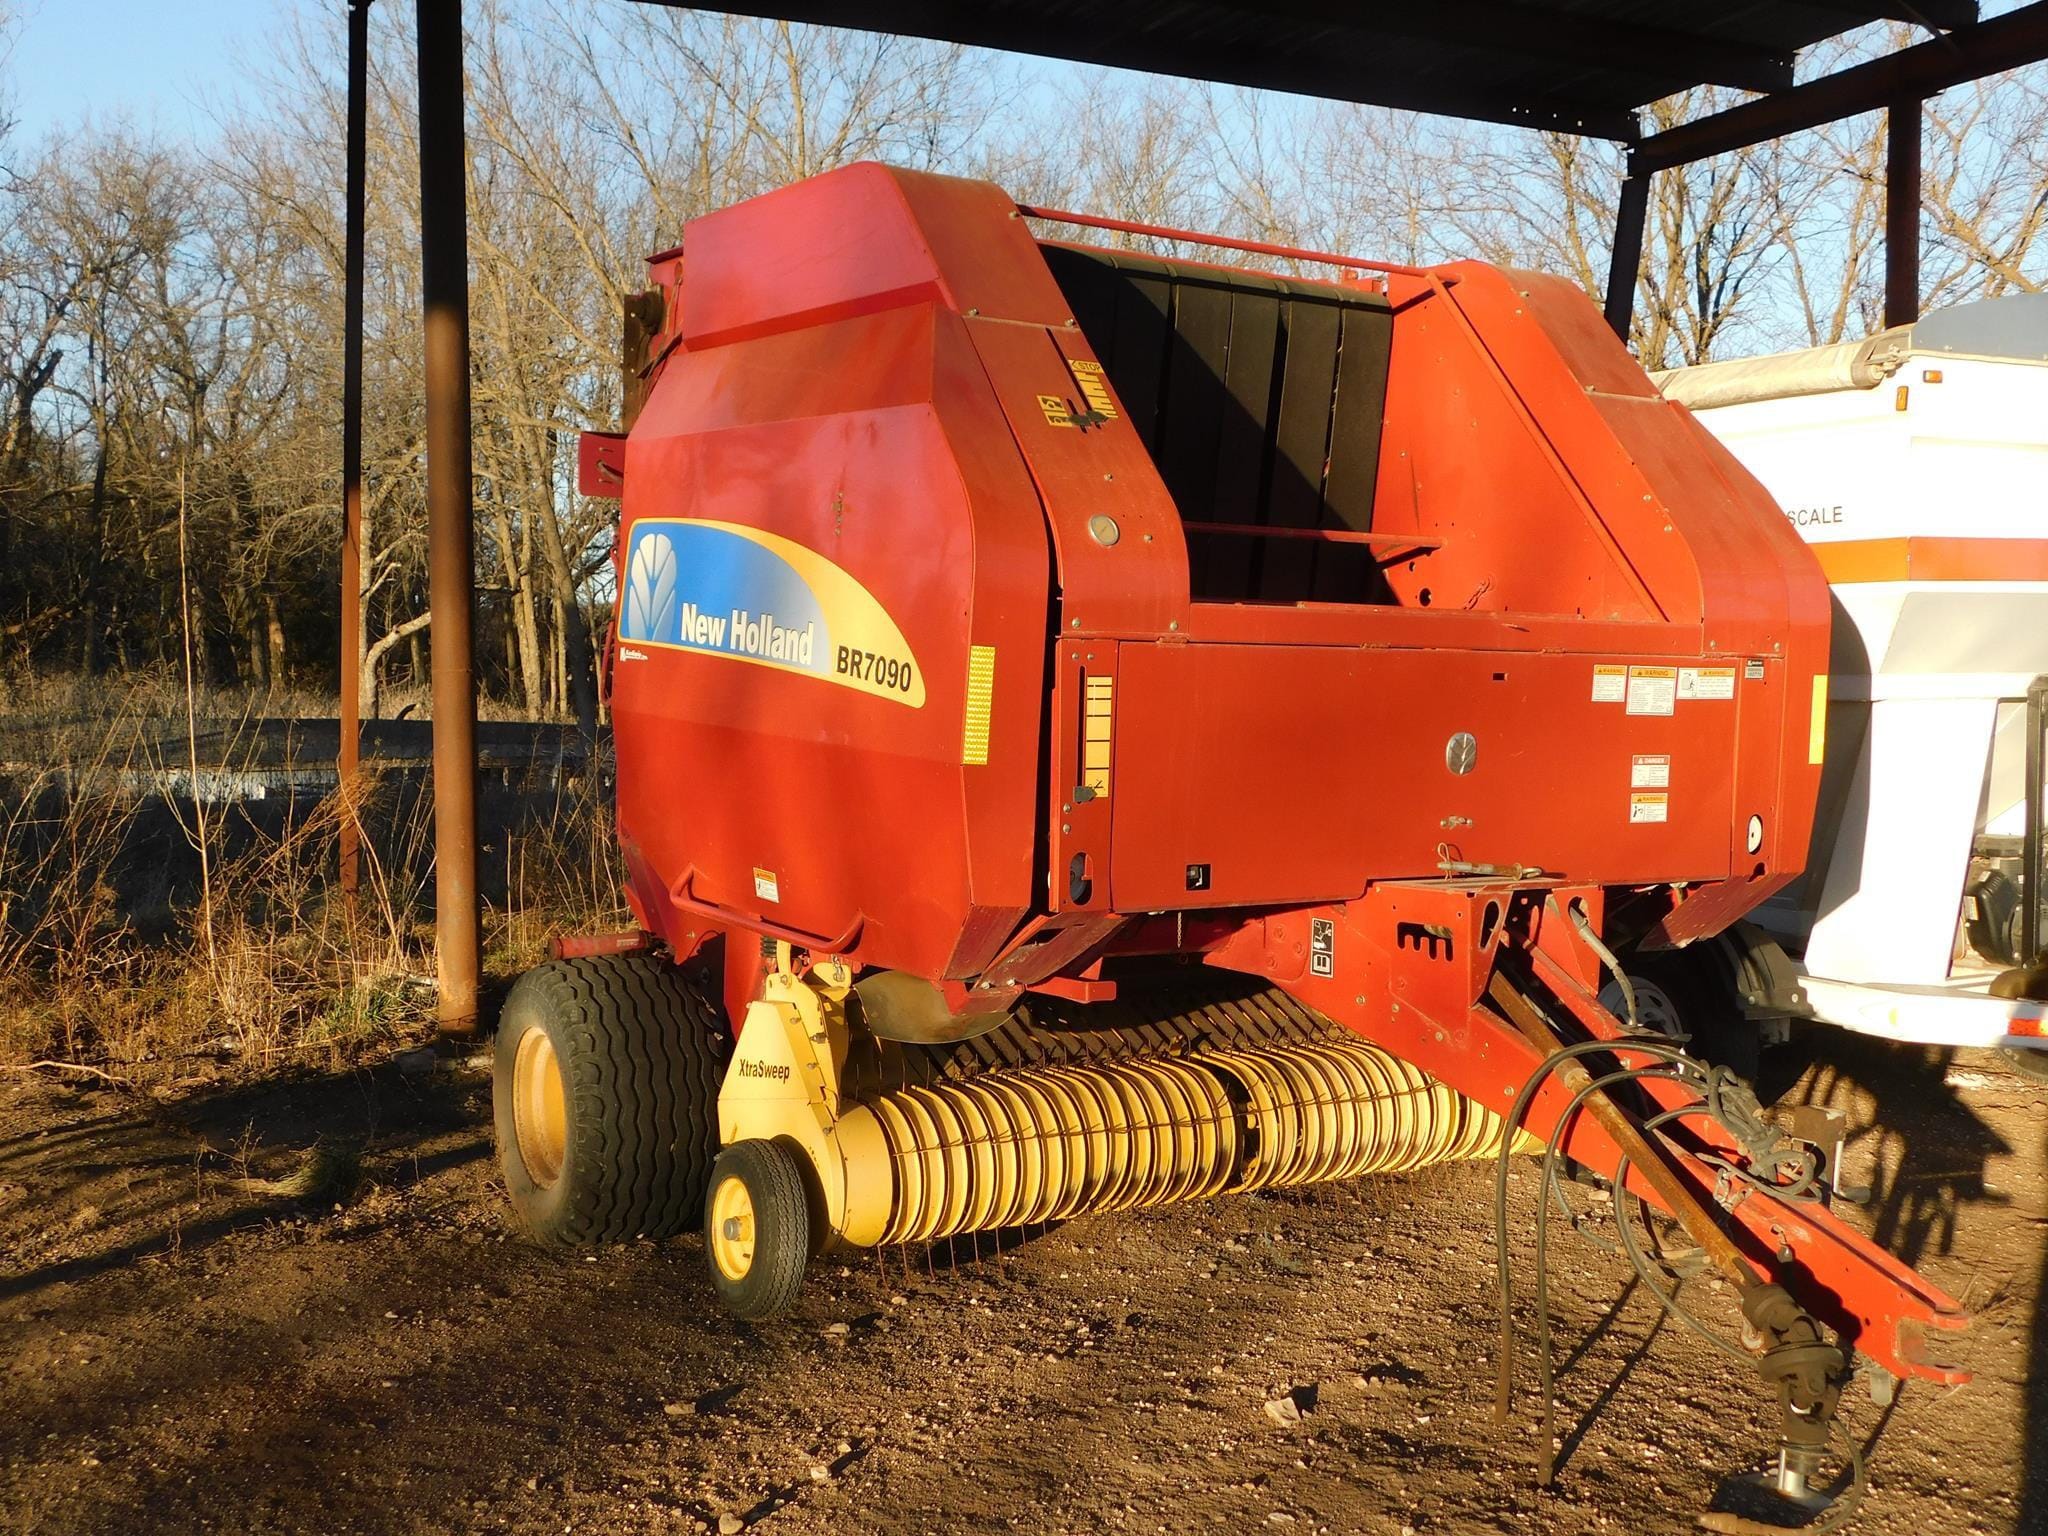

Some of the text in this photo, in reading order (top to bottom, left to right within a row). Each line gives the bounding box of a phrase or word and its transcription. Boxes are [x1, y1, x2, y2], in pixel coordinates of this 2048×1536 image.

[1786, 506, 1843, 525] SCALE
[680, 602, 814, 665] New Holland
[836, 645, 913, 692] BR7090
[739, 1058, 790, 1084] XtraSweep
